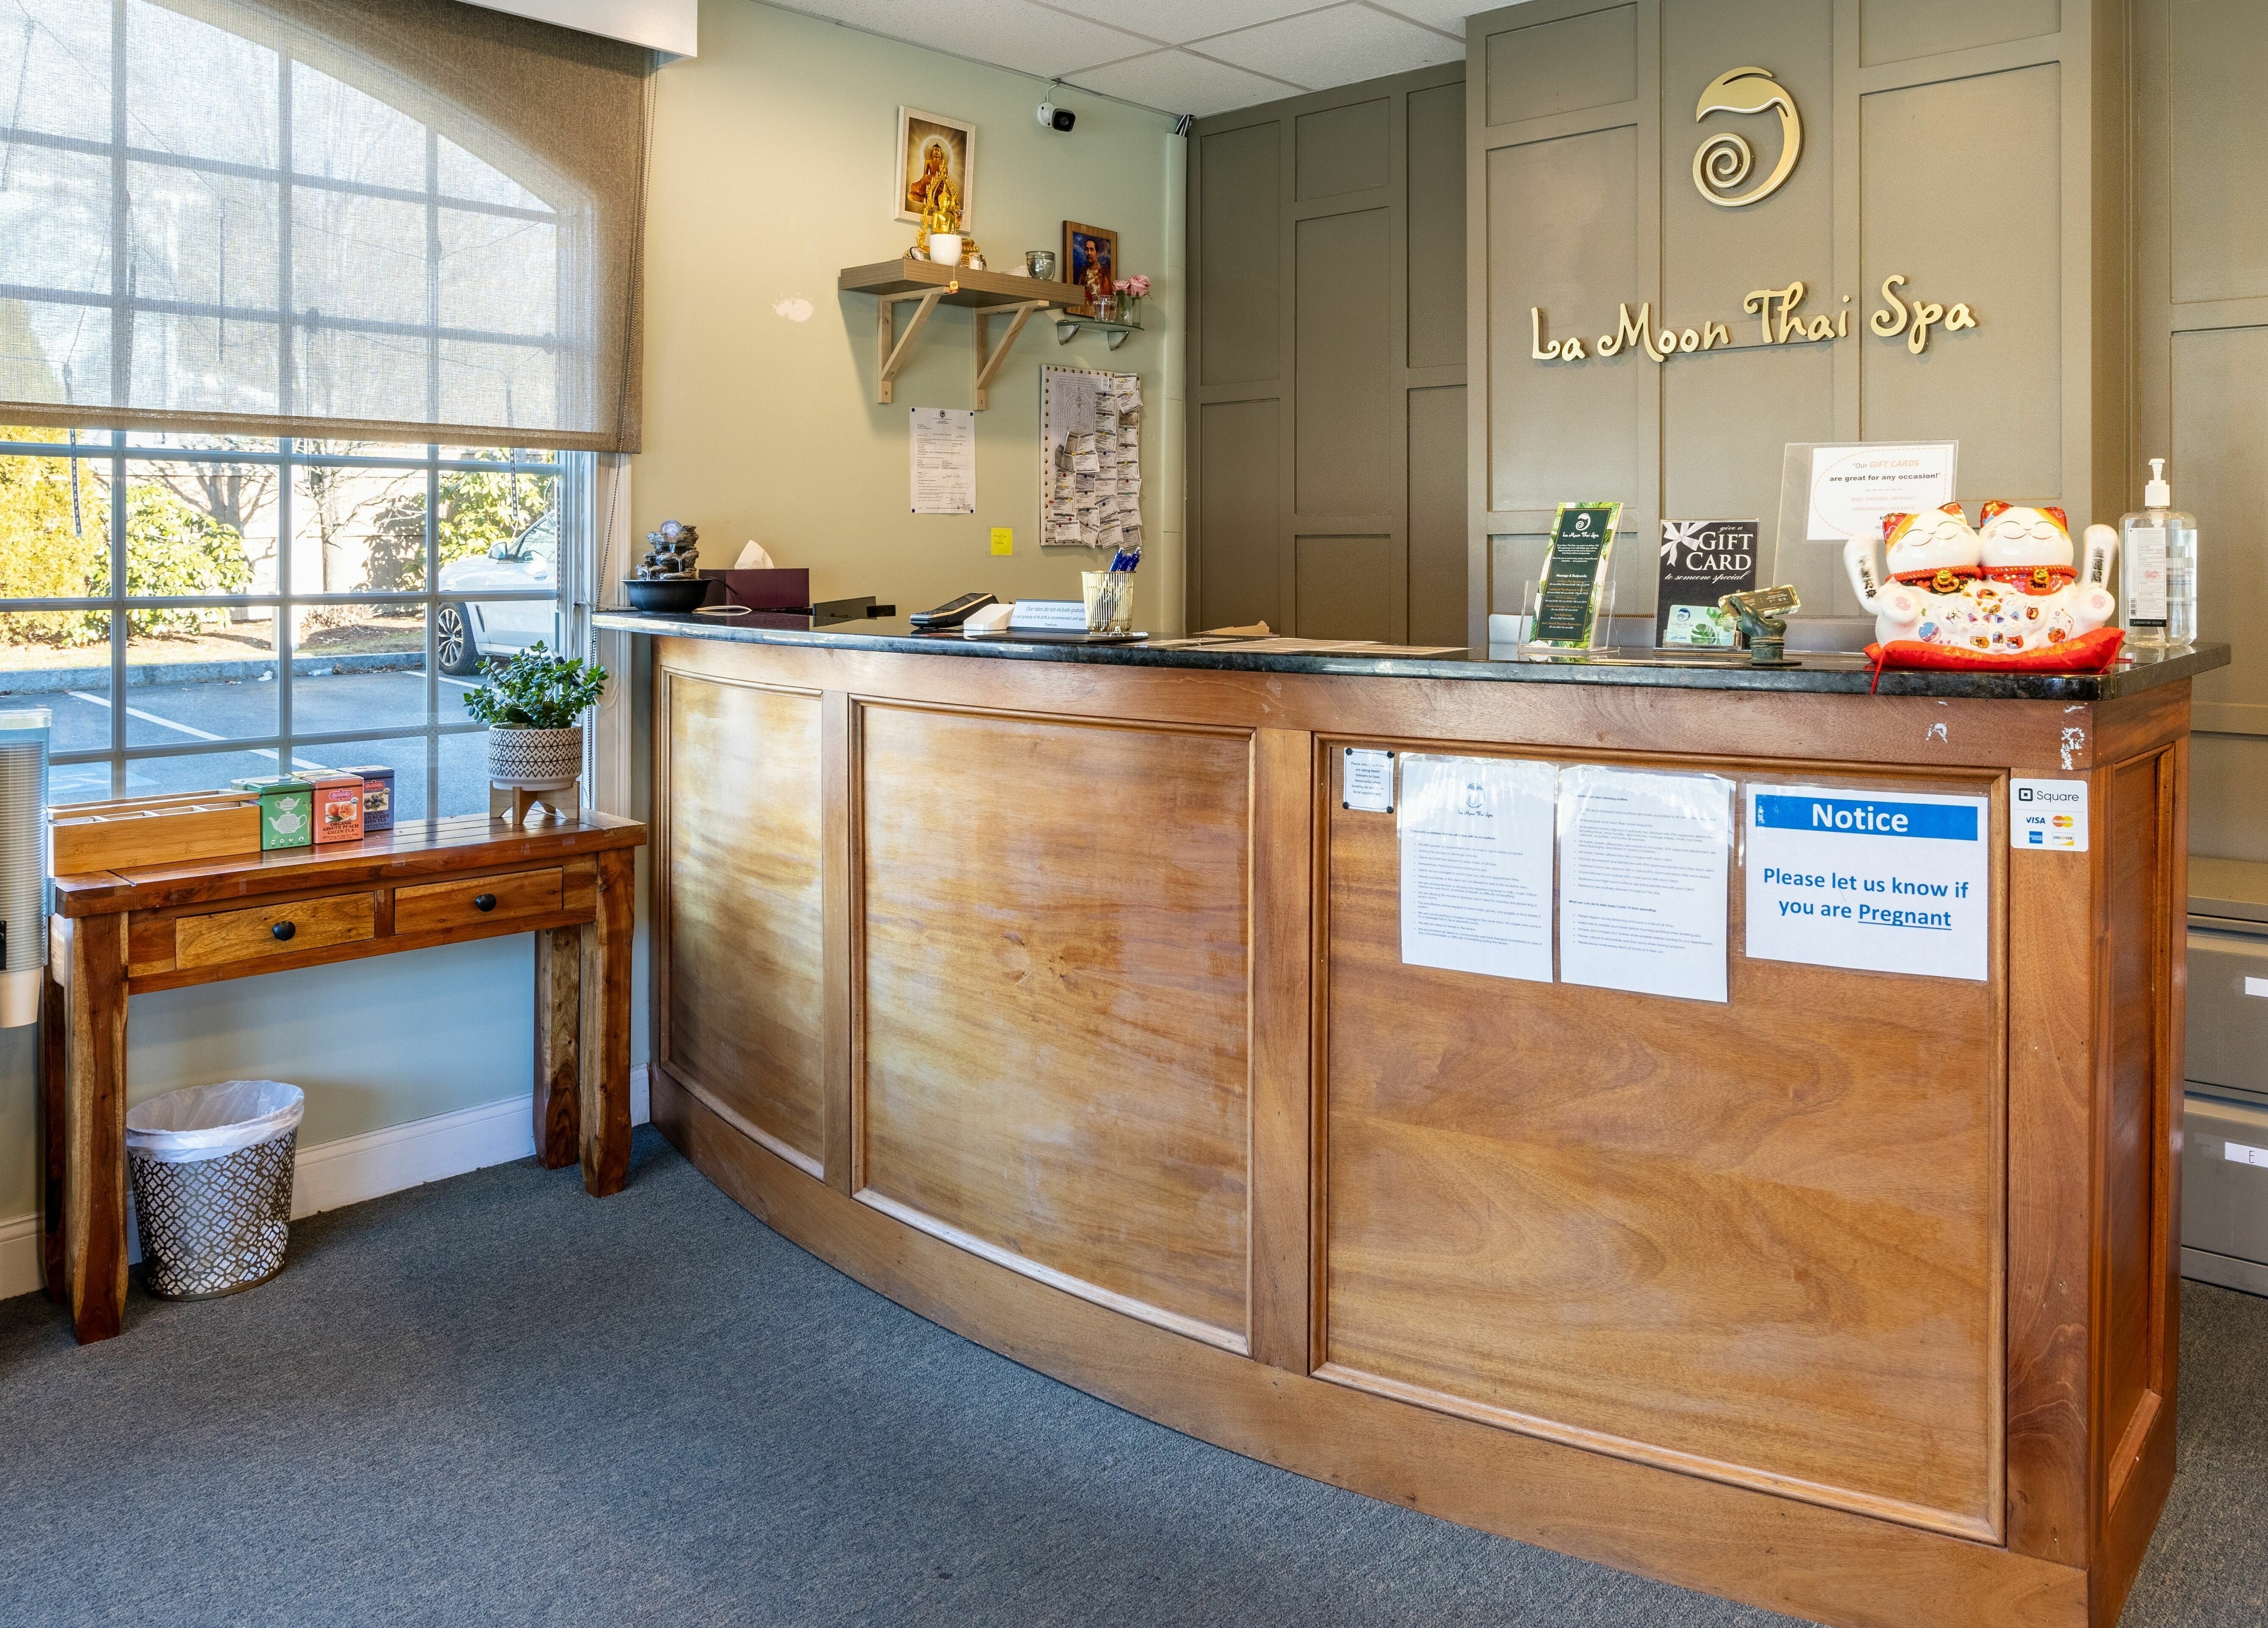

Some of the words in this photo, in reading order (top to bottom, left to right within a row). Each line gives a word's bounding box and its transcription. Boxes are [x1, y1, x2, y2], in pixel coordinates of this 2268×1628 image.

[1531, 307, 1585, 362] La
[1597, 302, 1731, 362] Moon
[1743, 281, 1851, 344] Thai
[1871, 275, 1976, 354] Spa
[1718, 525, 1736, 533] give
[1699, 532, 1753, 550] GIFT
[1686, 552, 1751, 571] CARD
[1712, 571, 1751, 584] special
[2036, 790, 2079, 802] Square
[1812, 803, 1908, 832] Notice
[1764, 868, 1825, 887] Please
[1832, 872, 1857, 890] let
[1864, 878, 1885, 893] us
[1892, 877, 1948, 897] know
[1955, 881, 1969, 898] if
[1779, 900, 1814, 916] you
[1820, 904, 1852, 918] are
[1859, 904, 1951, 927] Pregnant
[2248, 1150, 2256, 1164] E
